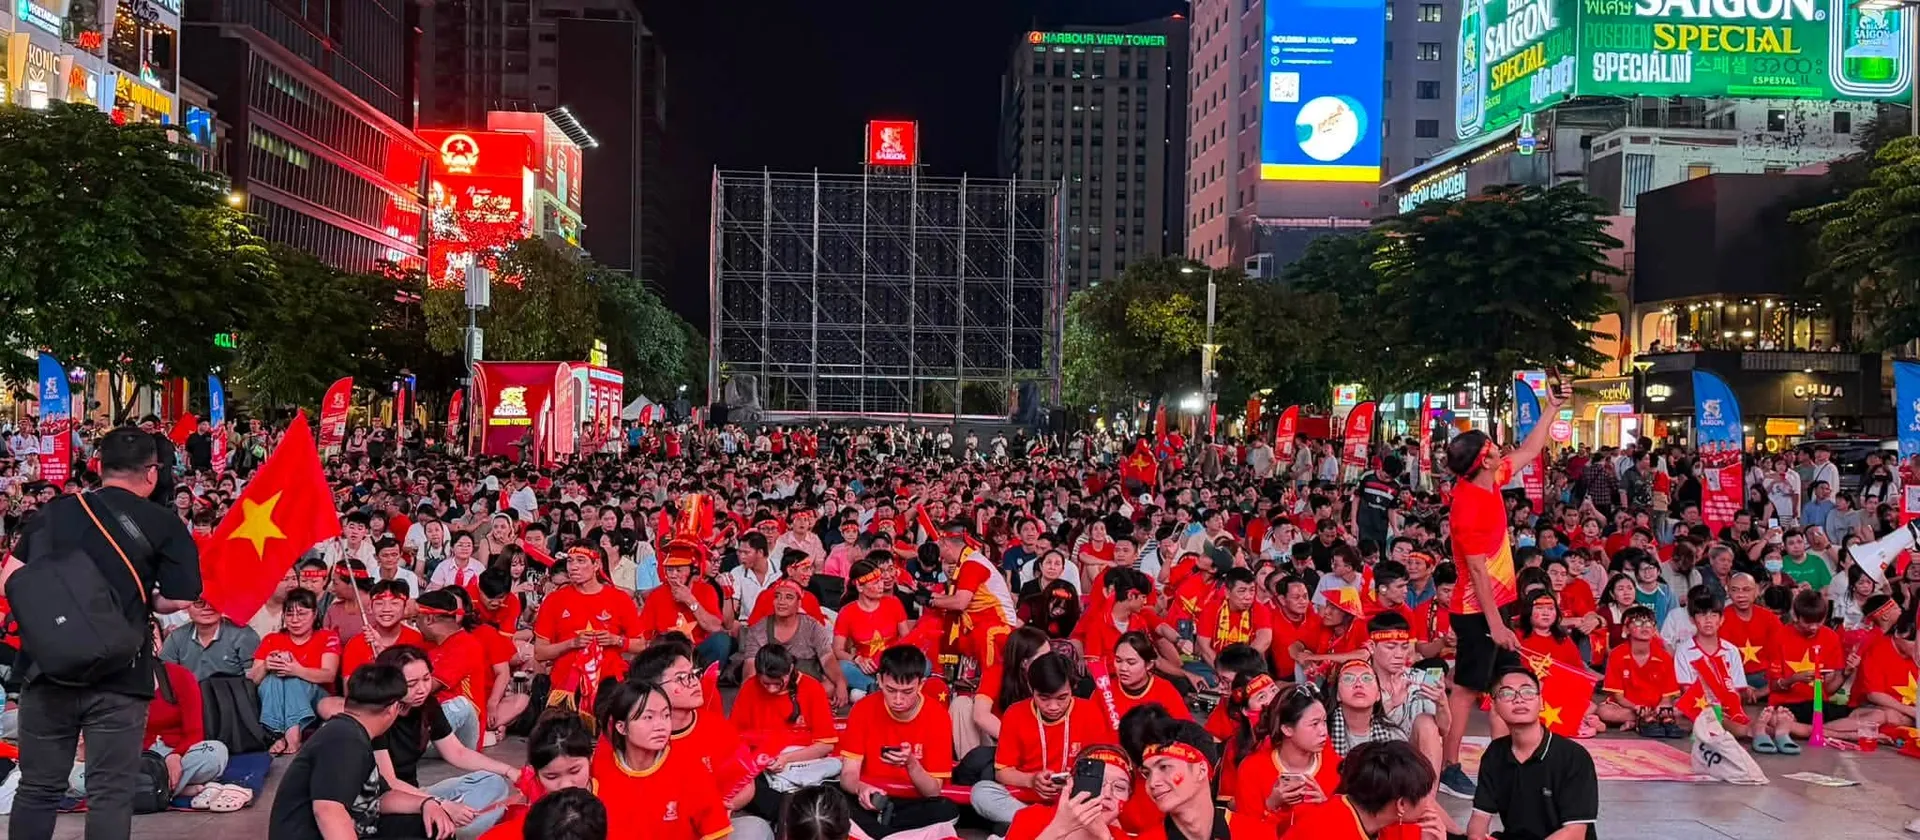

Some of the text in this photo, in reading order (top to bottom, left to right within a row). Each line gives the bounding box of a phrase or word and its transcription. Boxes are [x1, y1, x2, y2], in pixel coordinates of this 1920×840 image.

[1042, 32, 1165, 46] HARBOUR VIEW TOWER
[1307, 36, 1331, 44] MEDIA
[1653, 24, 1801, 53] SPECIAL
[1855, 29, 1890, 39] SAIGON
[1491, 42, 1547, 91] SPECIAL
[1592, 50, 1693, 83] SPECIÁLNÍ
[1753, 76, 1796, 85] ESPESYAL
[1399, 171, 1467, 214] SAIGON GARDEN
[1794, 384, 1843, 397] CHUA
